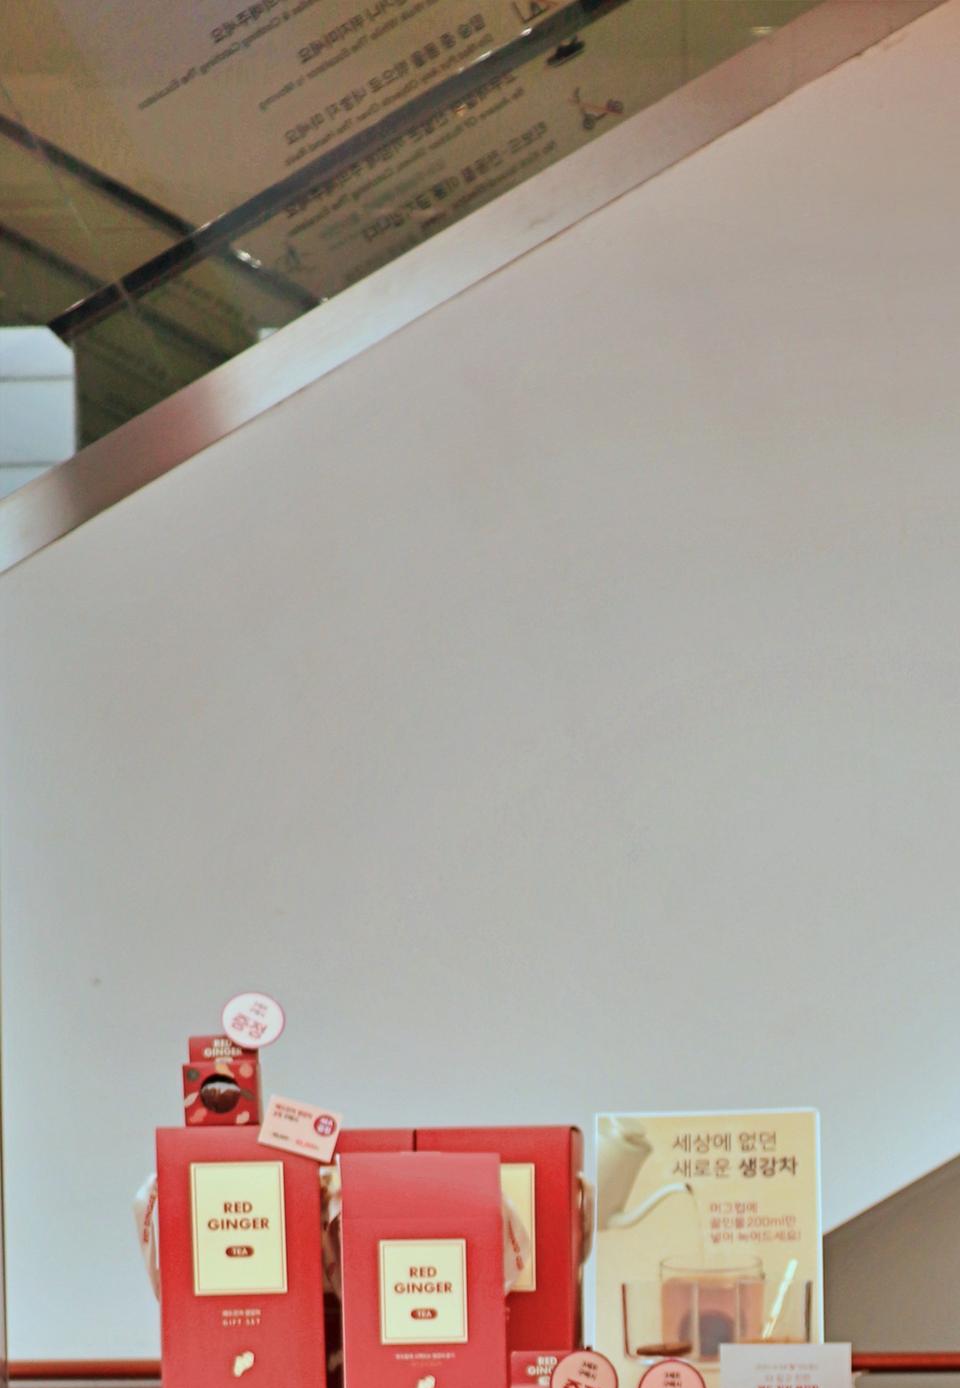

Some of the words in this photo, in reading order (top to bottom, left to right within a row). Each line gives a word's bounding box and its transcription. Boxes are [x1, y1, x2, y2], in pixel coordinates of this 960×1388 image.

[672, 1133, 732, 1153] 세상에
[738, 1131, 777, 1151] 없던
[672, 1158, 731, 1178] 새로운
[738, 1156, 798, 1177] 생강차
[223, 1202, 253, 1214] RED
[208, 1218, 269, 1230] GINGER
[232, 1248, 248, 1256] TEA
[409, 1266, 437, 1277] RED
[394, 1282, 452, 1294] GINGER
[417, 1310, 432, 1318] TEA
[537, 1356, 557, 1365] RED
